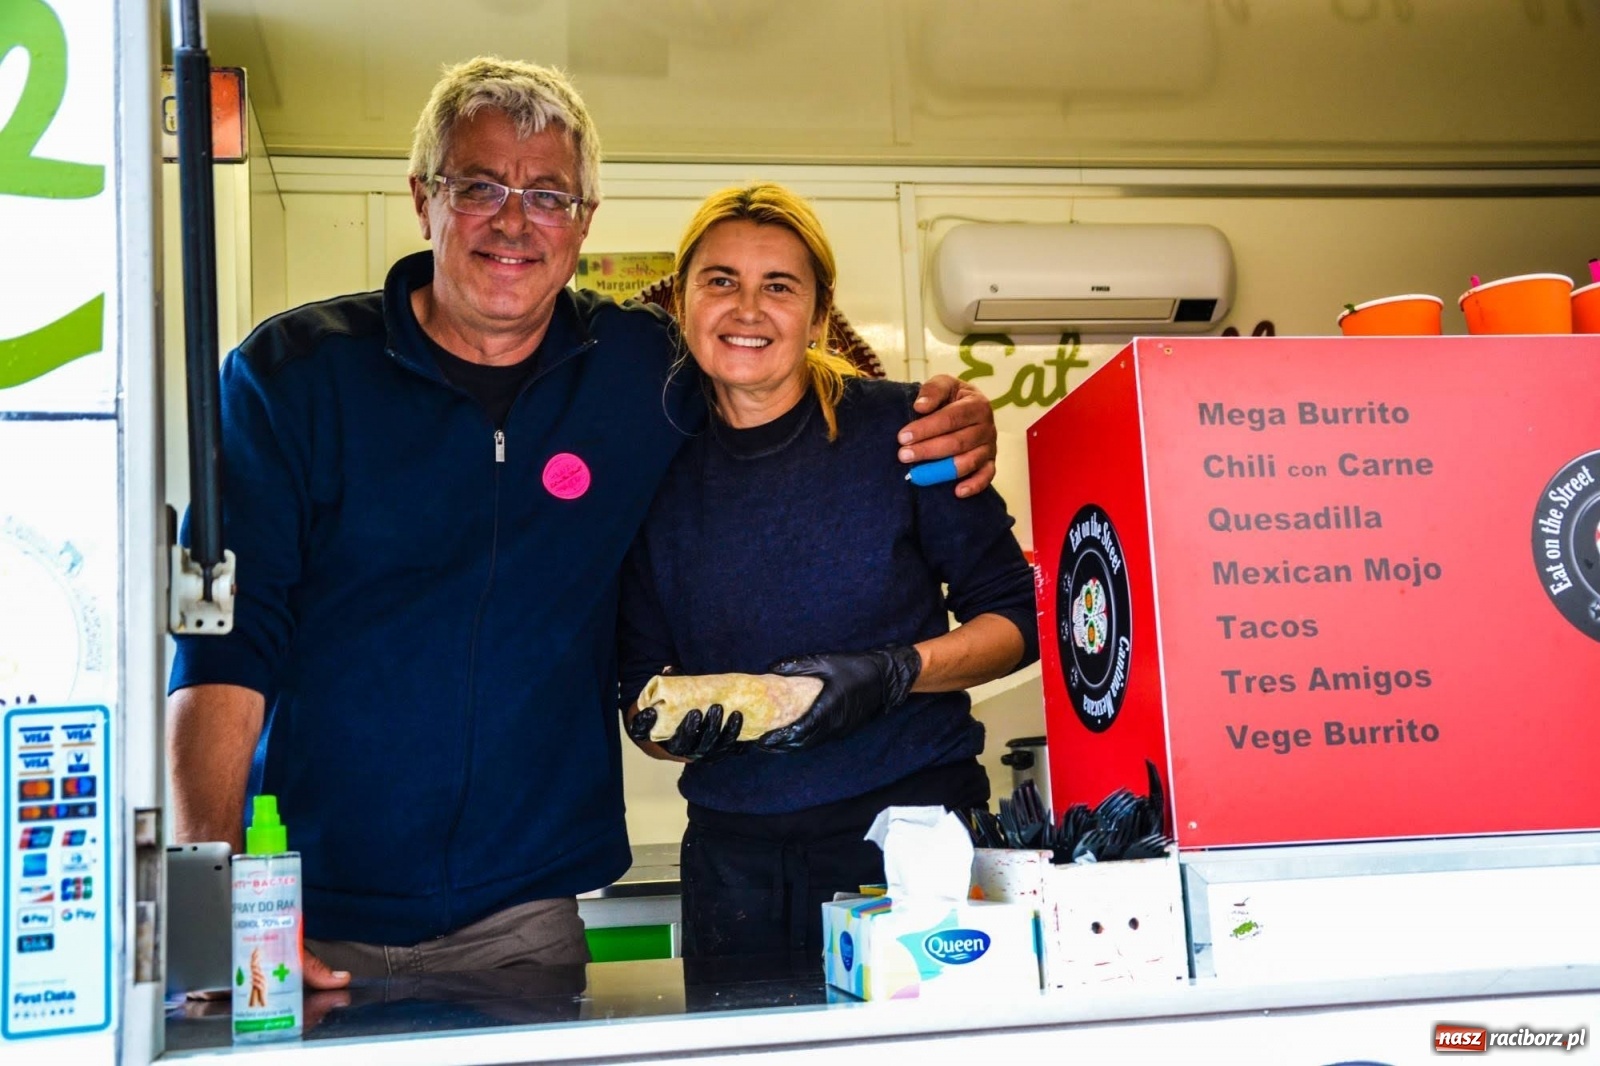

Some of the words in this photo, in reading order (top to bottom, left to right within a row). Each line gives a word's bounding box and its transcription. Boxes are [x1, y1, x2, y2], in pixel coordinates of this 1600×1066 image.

[1198, 402, 1286, 431] Mega
[1298, 401, 1410, 425] Burrito
[1203, 454, 1276, 478] Chili
[1288, 464, 1327, 477] con
[1338, 453, 1433, 477] Carne
[1548, 465, 1595, 509] Street
[1208, 506, 1382, 532] Quesadilla
[1539, 508, 1564, 535] the
[1091, 512, 1101, 540] the
[1101, 522, 1121, 575] Street
[1545, 539, 1561, 560] on
[1212, 560, 1352, 585] Mexican
[1364, 557, 1441, 587] Mojo
[1546, 562, 1573, 596] Eat
[1216, 615, 1319, 640] Tacos
[1220, 670, 1296, 694] Tres
[1308, 666, 1432, 695] Amigos
[23, 733, 51, 743] VISA
[66, 729, 92, 741] VISA
[1226, 725, 1312, 755] Vege
[1324, 719, 1440, 746] Burrito
[24, 758, 49, 768] VISA
[258, 901, 274, 912] DO
[928, 936, 984, 958] Queen
[44, 990, 76, 1002] Data
